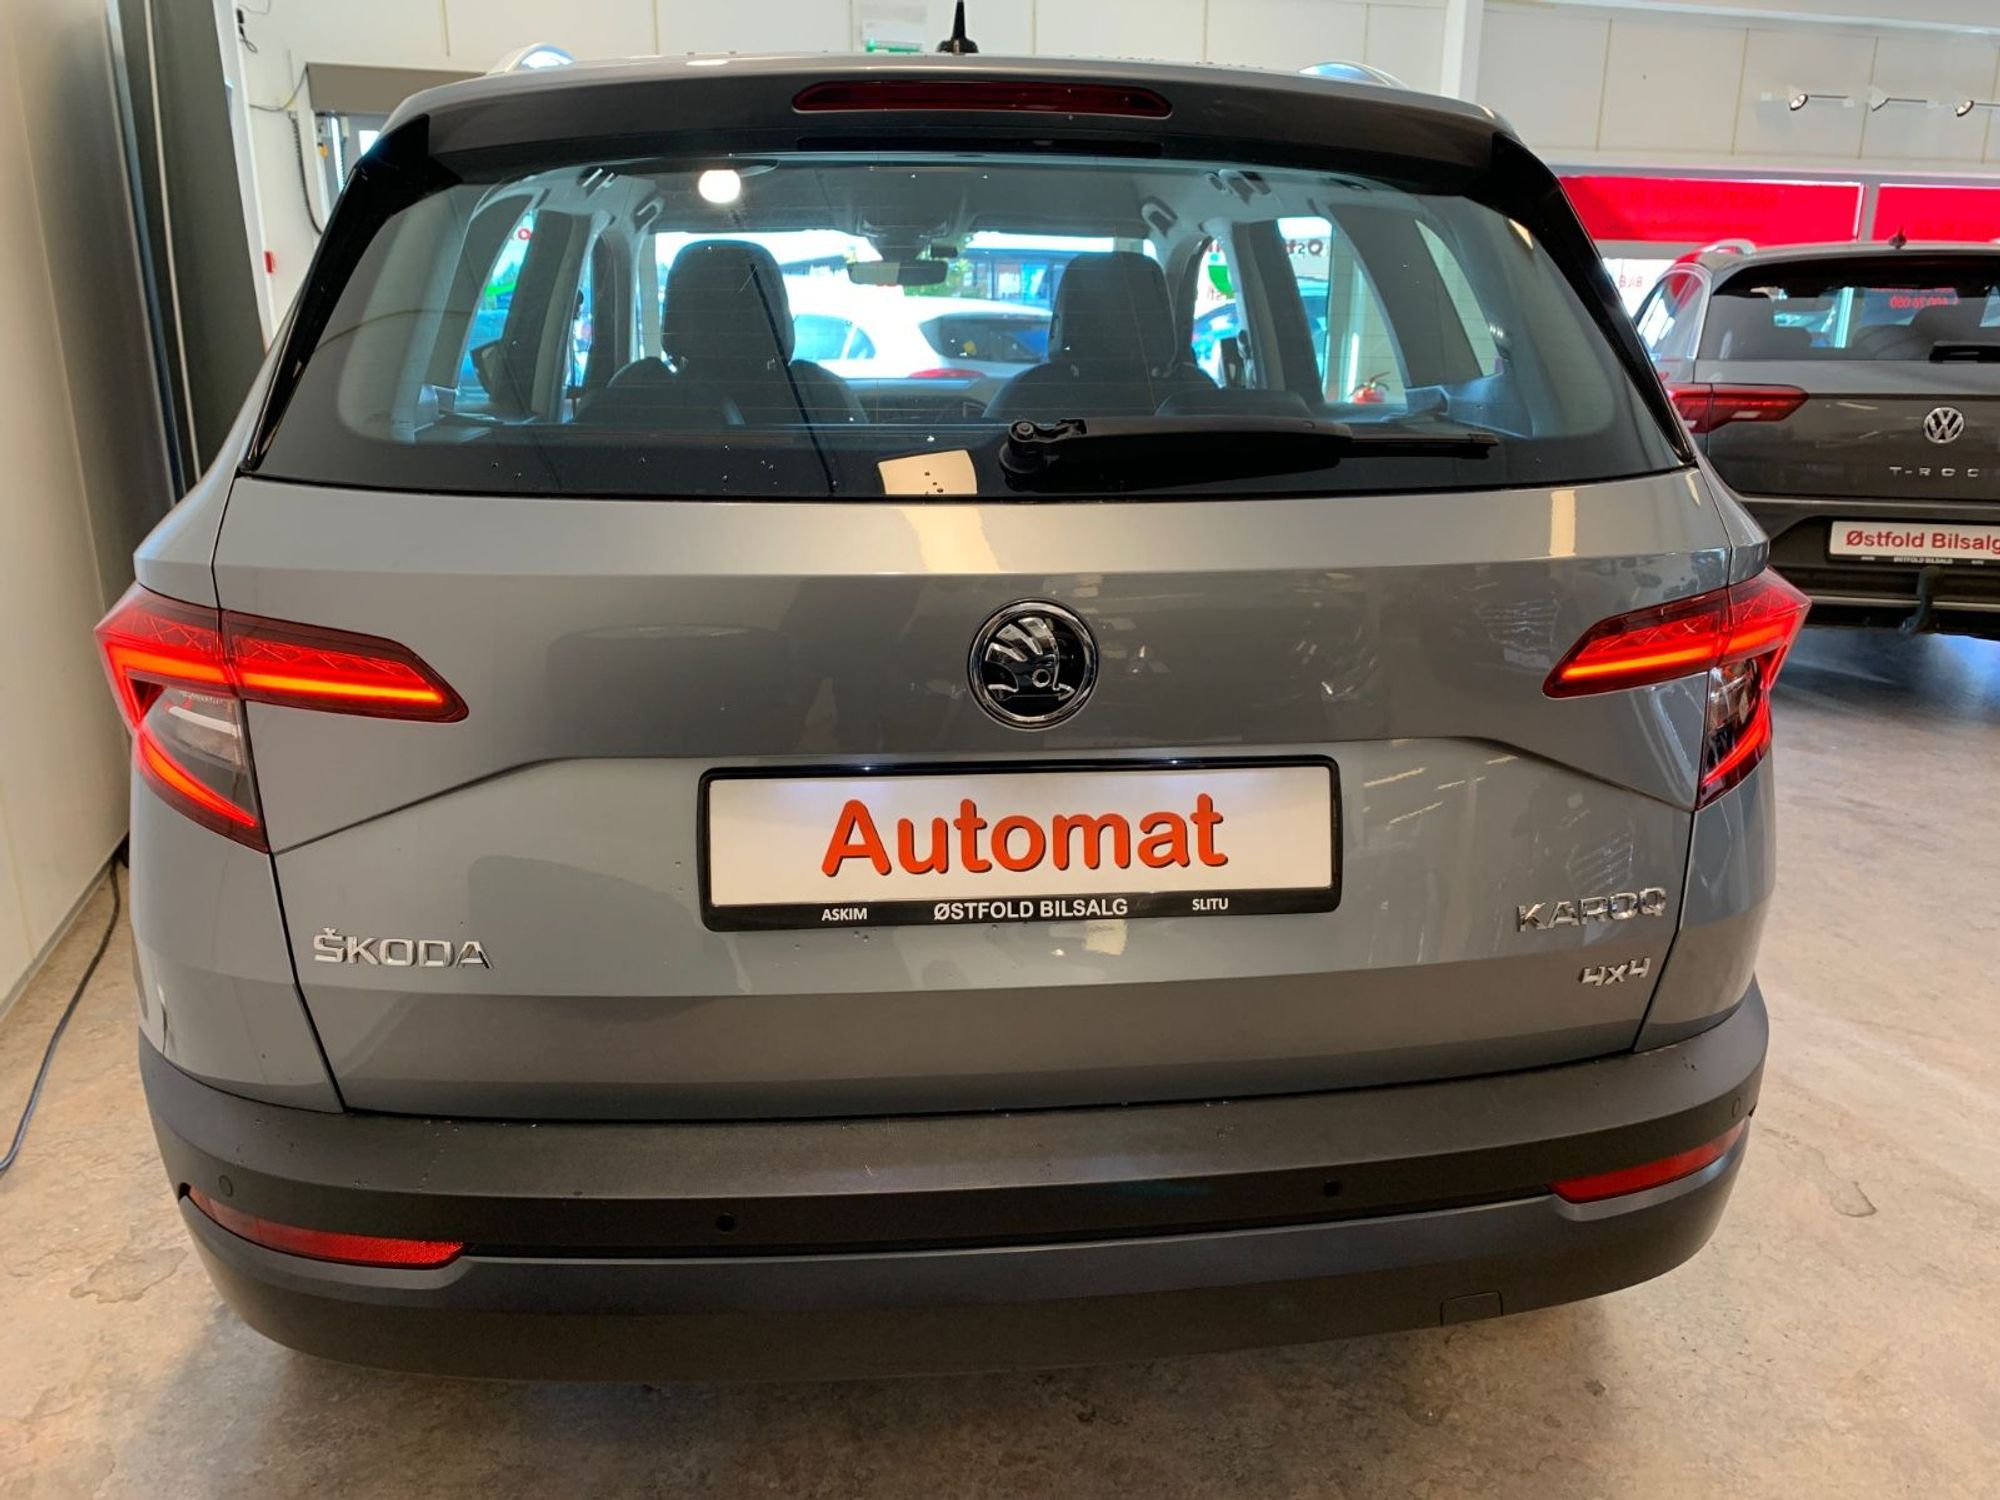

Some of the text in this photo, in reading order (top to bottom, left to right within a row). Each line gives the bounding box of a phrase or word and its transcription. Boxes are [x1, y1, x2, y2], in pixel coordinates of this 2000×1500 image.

[1846, 530, 2000, 554] Østfold Bilsalg
[821, 793, 1228, 876] Automat
[821, 906, 868, 922] ASKIM
[933, 898, 1129, 921] ØSTFOLD BILSALG
[1192, 898, 1229, 911] SLITU
[1517, 887, 1667, 932] KAROQ
[313, 927, 493, 969] ŠKODA
